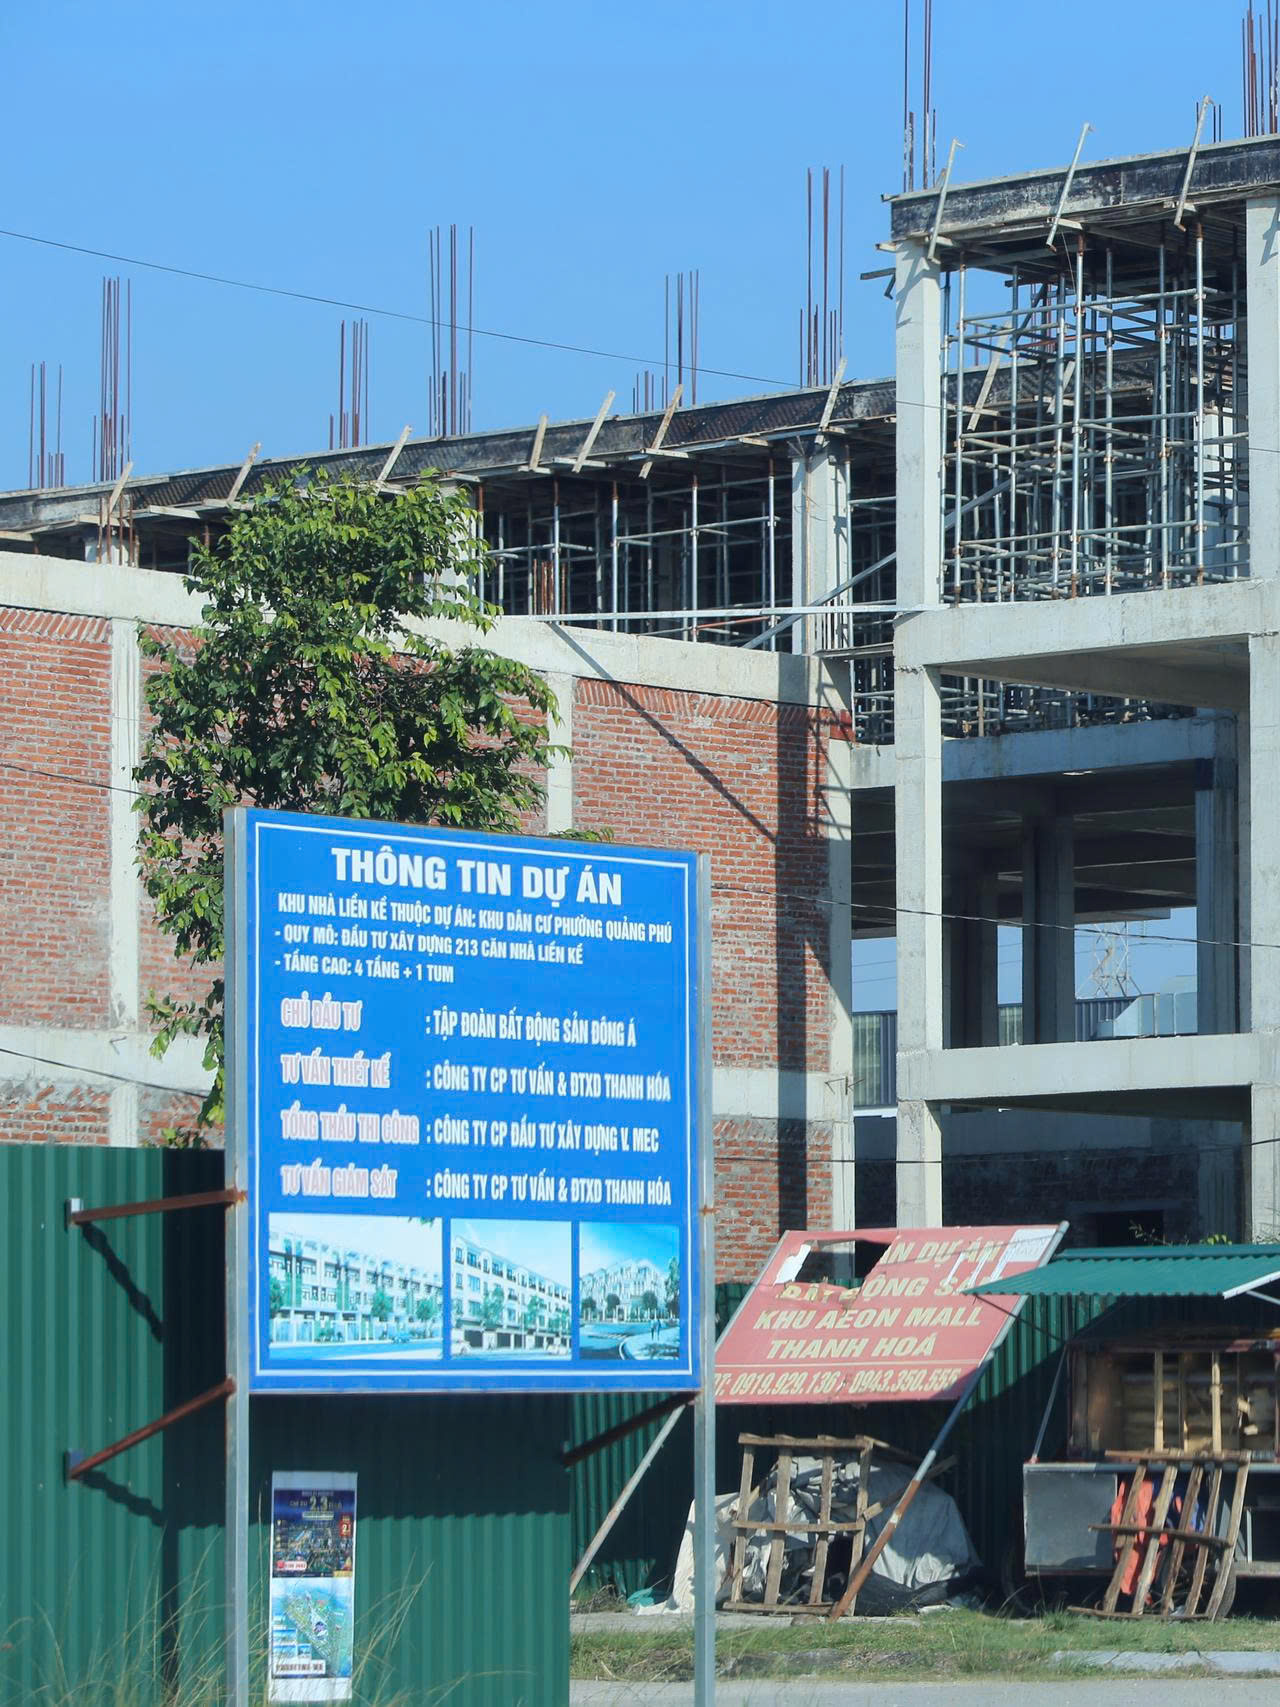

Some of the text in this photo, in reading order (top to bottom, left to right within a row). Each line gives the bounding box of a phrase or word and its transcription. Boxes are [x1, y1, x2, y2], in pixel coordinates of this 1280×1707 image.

[331, 845, 622, 908] THÔNG TIN DỰ ÁN
[278, 892, 305, 914] KHU
[308, 892, 336, 916] NHÀ
[390, 900, 431, 927] THUỘC
[434, 905, 453, 930] DỰ
[454, 904, 476, 928] ÁN:
[479, 909, 504, 931] KHU
[507, 909, 533, 933] DÂN
[535, 913, 553, 935] CƯ
[554, 913, 603, 938] PHƯỜNG
[605, 915, 646, 942] QUẢNG
[648, 921, 672, 944] PHÚ
[284, 924, 310, 944] QUY
[313, 924, 338, 946] MÔ:
[341, 924, 368, 948] ĐẦU
[370, 930, 389, 950] TƯ
[390, 930, 416, 952] XÂY
[418, 933, 452, 957] DỰNG
[455, 938, 479, 957] 213
[481, 937, 507, 959] CĂN
[509, 940, 536, 961] NHÀ
[322, 955, 352, 976] CAO:
[354, 959, 363, 977] 4
[416, 964, 422, 981] 1
[427, 964, 454, 983] TUM
[281, 990, 363, 1032] CHỦ ĐẦU TƯ
[433, 1005, 458, 1041] TẬP
[460, 1007, 497, 1039] ĐOÀN
[499, 1006, 523, 1040] BẤT
[525, 1011, 560, 1047] ĐỘNG
[563, 1010, 589, 1045] SẢN
[591, 1015, 625, 1047] ĐÔNG
[627, 1017, 637, 1048] Á
[280, 1047, 391, 1089] TƯ VẤN THIẾT KẾ
[433, 1059, 469, 1091] CÔNG
[471, 1066, 488, 1092] TY
[490, 1066, 508, 1094] CP
[510, 1066, 528, 1095] TƯ
[528, 1061, 554, 1096] VẤN
[557, 1071, 567, 1097] &
[570, 1072, 601, 1099] ĐTXD
[604, 1073, 644, 1101] THANH
[646, 1070, 672, 1102] HÓA
[280, 1099, 420, 1145] TỔNG THẦU THI CÔNG
[434, 1113, 470, 1145] CÔNG
[472, 1119, 488, 1145] TY
[490, 1120, 508, 1147] CP
[538, 1120, 556, 1150] TƯ
[557, 1119, 582, 1150] XÂY
[584, 1123, 618, 1156] DỰNG
[632, 1127, 659, 1153] MEC
[280, 1157, 398, 1199] TƯ VẤN GIÁM SÁT
[434, 1167, 470, 1200] CÔNG
[472, 1174, 488, 1200] TY
[490, 1174, 508, 1201] CP
[511, 1173, 528, 1201] TƯ
[529, 1167, 555, 1202] VẤN
[558, 1177, 568, 1202] &
[570, 1177, 602, 1204] ĐTXD
[605, 1178, 644, 1205] THANH
[647, 1175, 672, 1206] HÓA
[914, 1240, 960, 1268] DỰ
[753, 1306, 983, 1330] KHU AEON MALL
[766, 1332, 938, 1360] THANH HOÁ
